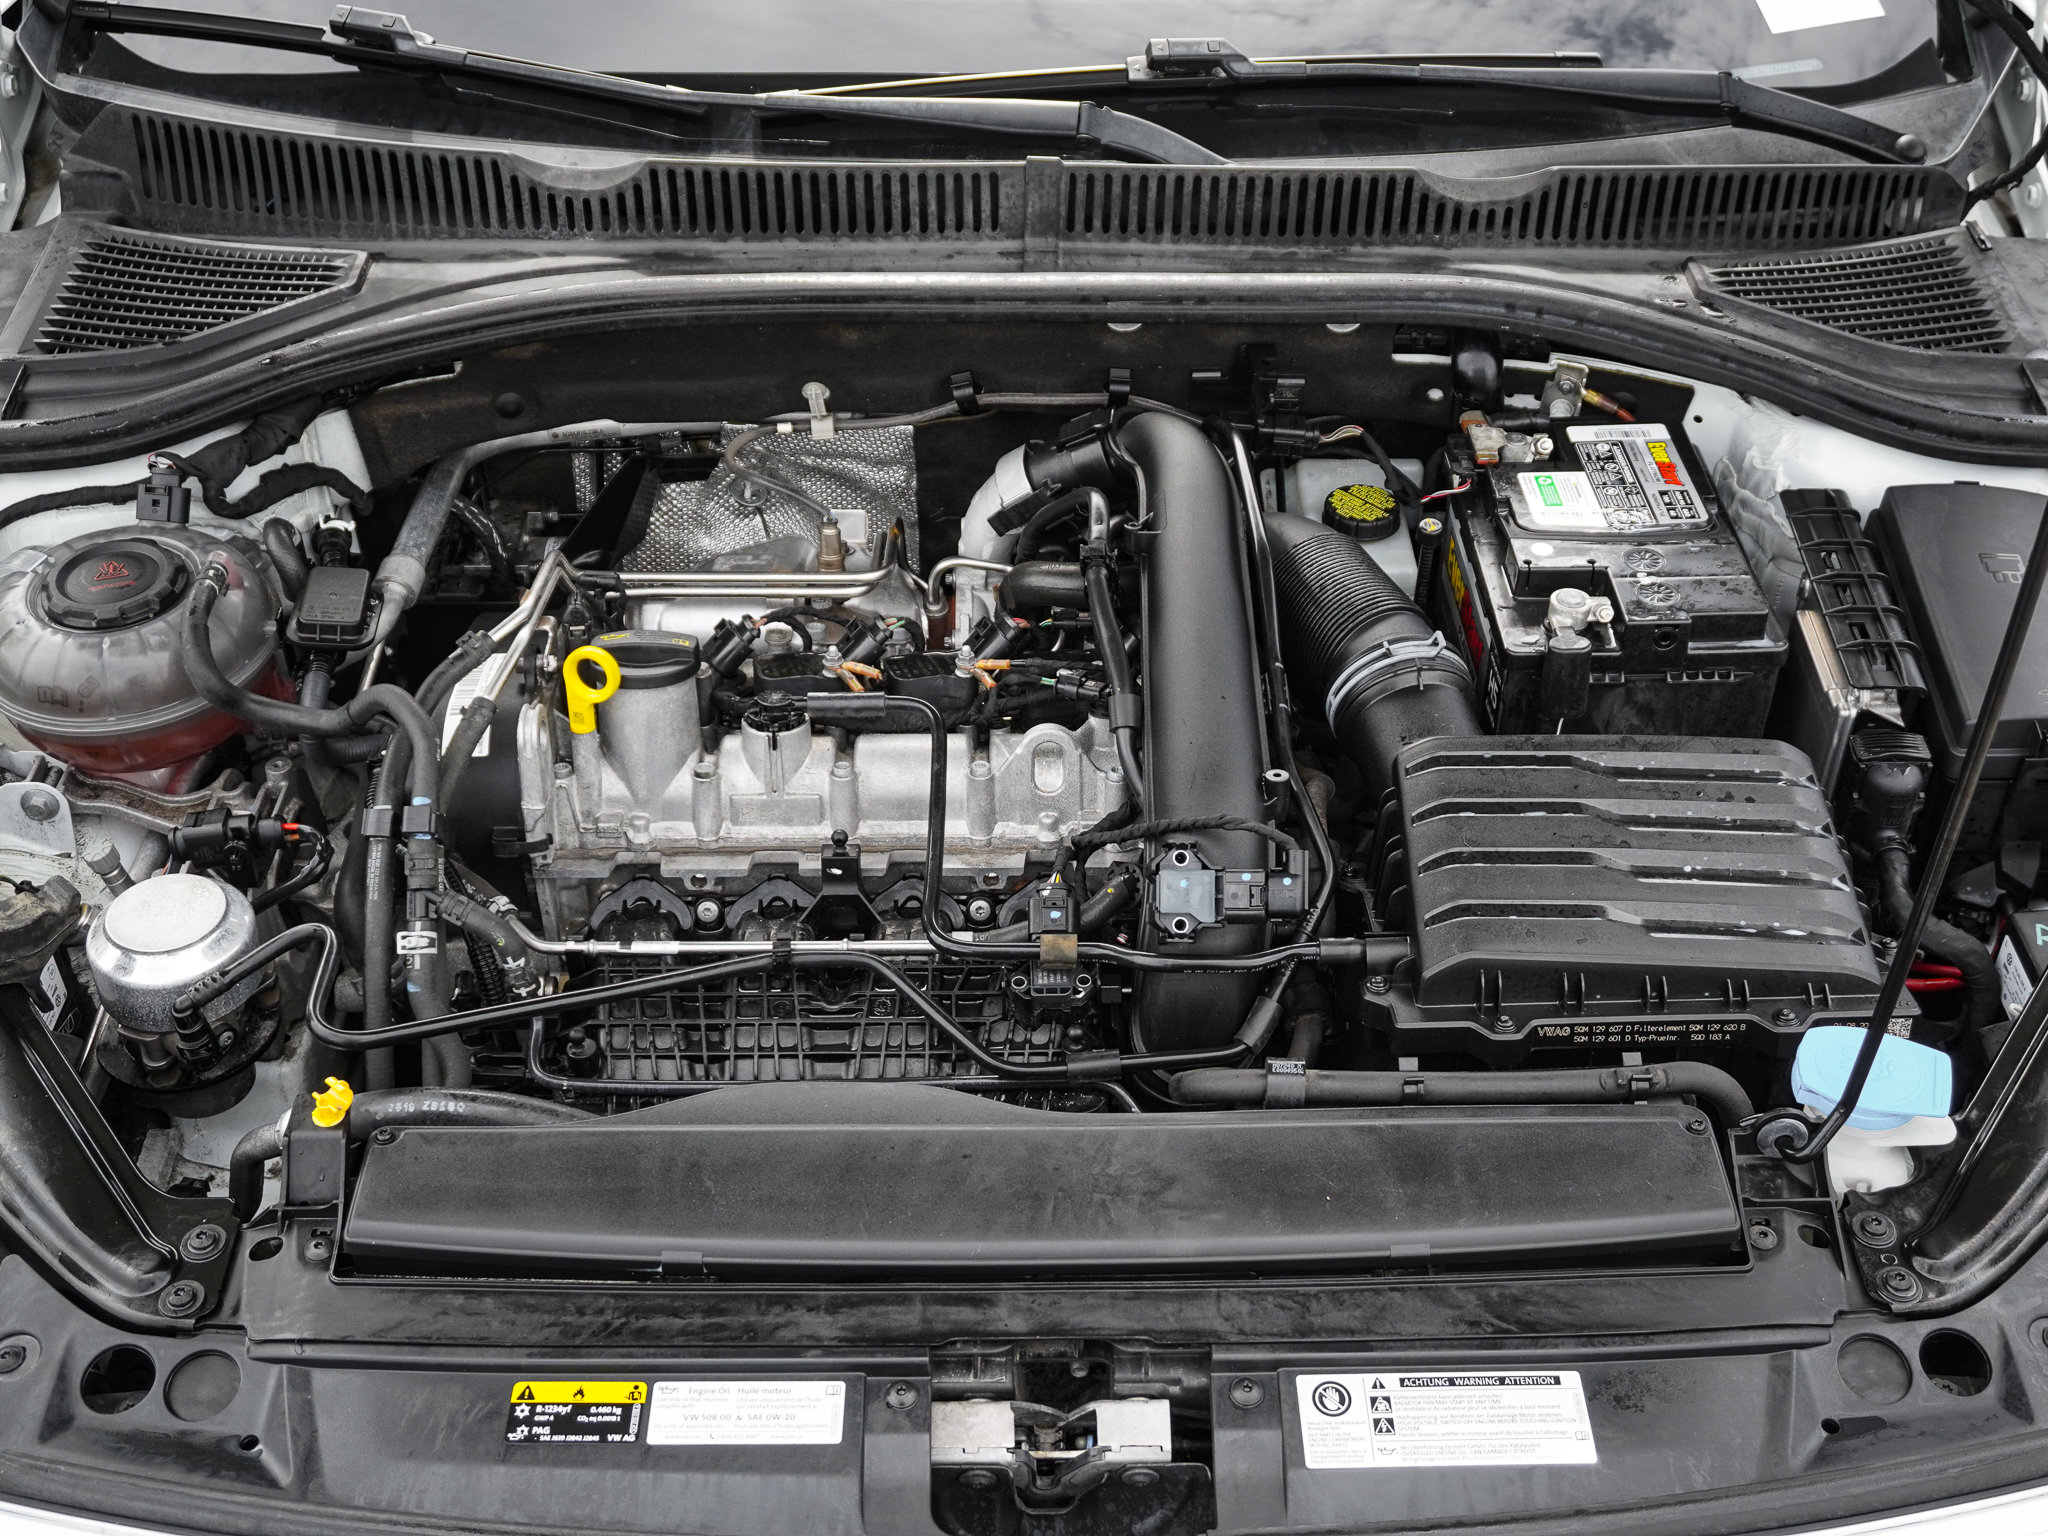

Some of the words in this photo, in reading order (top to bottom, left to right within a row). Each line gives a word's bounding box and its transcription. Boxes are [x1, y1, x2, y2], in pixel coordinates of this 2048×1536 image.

[1608, 1024, 1623, 1032] 607
[1634, 1024, 1686, 1032] Filterelement
[1404, 1378, 1449, 1386] ACHTUNG
[1454, 1378, 1499, 1386] WARNING
[1504, 1377, 1554, 1385] ATTENTION
[688, 1387, 716, 1396] Engine
[536, 1404, 572, 1415] R-1234yf
[612, 1406, 622, 1415] kg
[532, 1426, 550, 1434] PAG
[607, 1434, 622, 1442] VW
[622, 1434, 636, 1442] AG
